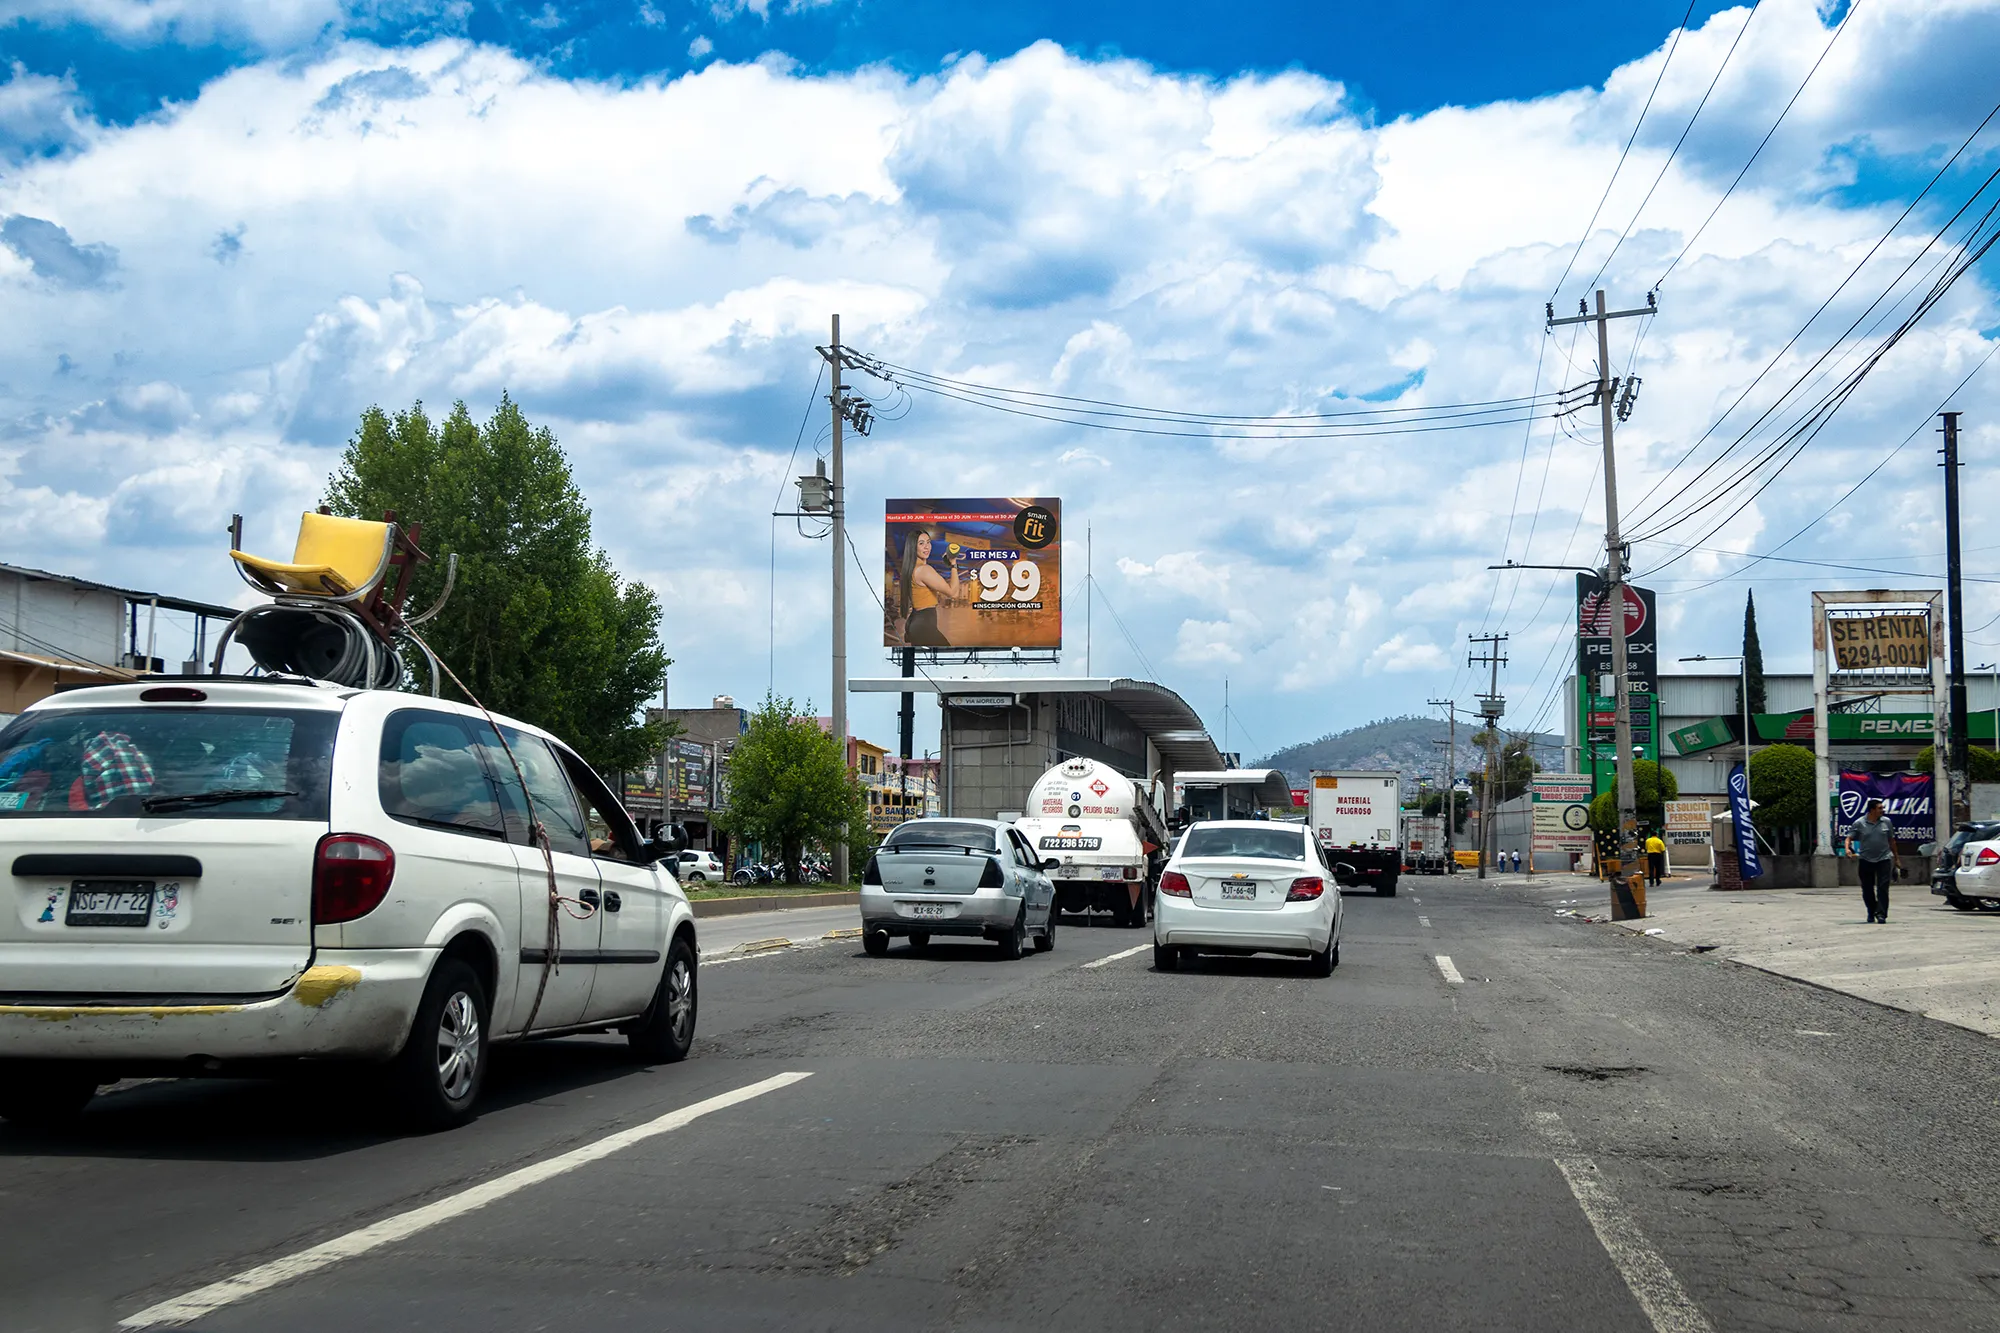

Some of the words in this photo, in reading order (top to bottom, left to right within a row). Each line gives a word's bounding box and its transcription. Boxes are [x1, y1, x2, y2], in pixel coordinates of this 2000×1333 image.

[1027, 511, 1048, 521] smart
[1023, 518, 1045, 537] fit
[970, 551, 986, 559] 1ER
[988, 551, 1008, 559] MES
[1009, 551, 1018, 559] A
[1833, 620, 1860, 642] SE
[1864, 618, 1926, 640] RENTA
[1587, 643, 1654, 655] PEEX
[1838, 643, 1926, 667] 5294-0011
[1533, 785, 1560, 793] SOLICITA
[1337, 796, 1371, 805] MATERIAL
[1042, 806, 1064, 814] PELIGROSO
[1082, 806, 1102, 814] PELIGRO
[1335, 807, 1372, 815] PELIGROSO
[1666, 803, 1675, 812] SE
[1677, 802, 1710, 812] SOLICITA
[1669, 813, 1707, 822] PERSONAL
[1737, 796, 1758, 870] ITALIKA
[1045, 838, 1060, 848] 722
[1061, 838, 1077, 848] 296
[1078, 838, 1099, 848] 5759
[71, 892, 148, 911] NSG-77-22
